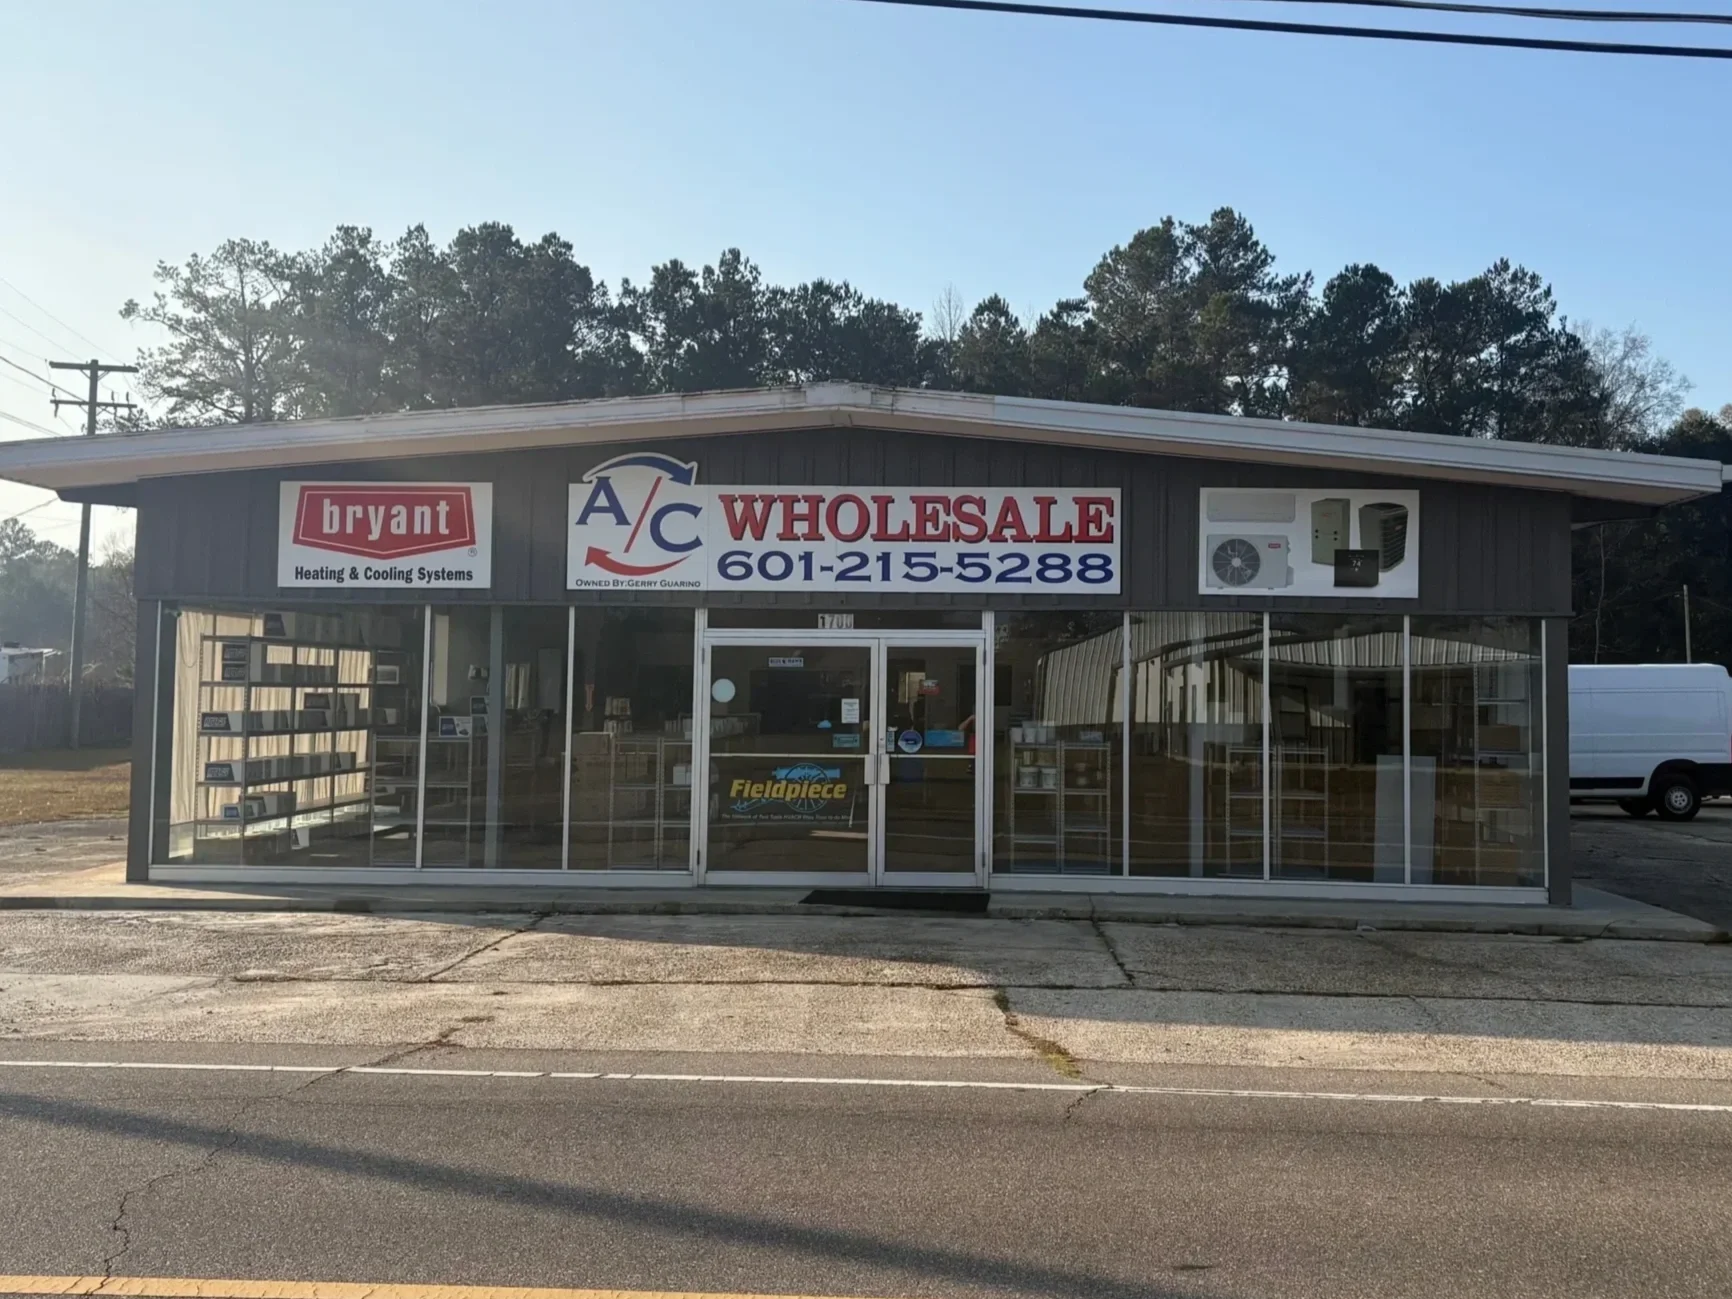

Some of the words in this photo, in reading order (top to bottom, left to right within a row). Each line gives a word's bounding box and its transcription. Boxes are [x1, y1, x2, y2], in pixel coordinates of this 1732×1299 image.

[322, 498, 450, 541] bryant
[575, 475, 703, 553] A/C
[718, 493, 1114, 544] WHOLESALE
[295, 566, 344, 583] Heating
[349, 567, 359, 580] &
[364, 566, 413, 583] Cooling
[417, 567, 473, 583] Systems
[717, 550, 1114, 584] 601-215-5288
[730, 779, 847, 801] Fieldpiece
